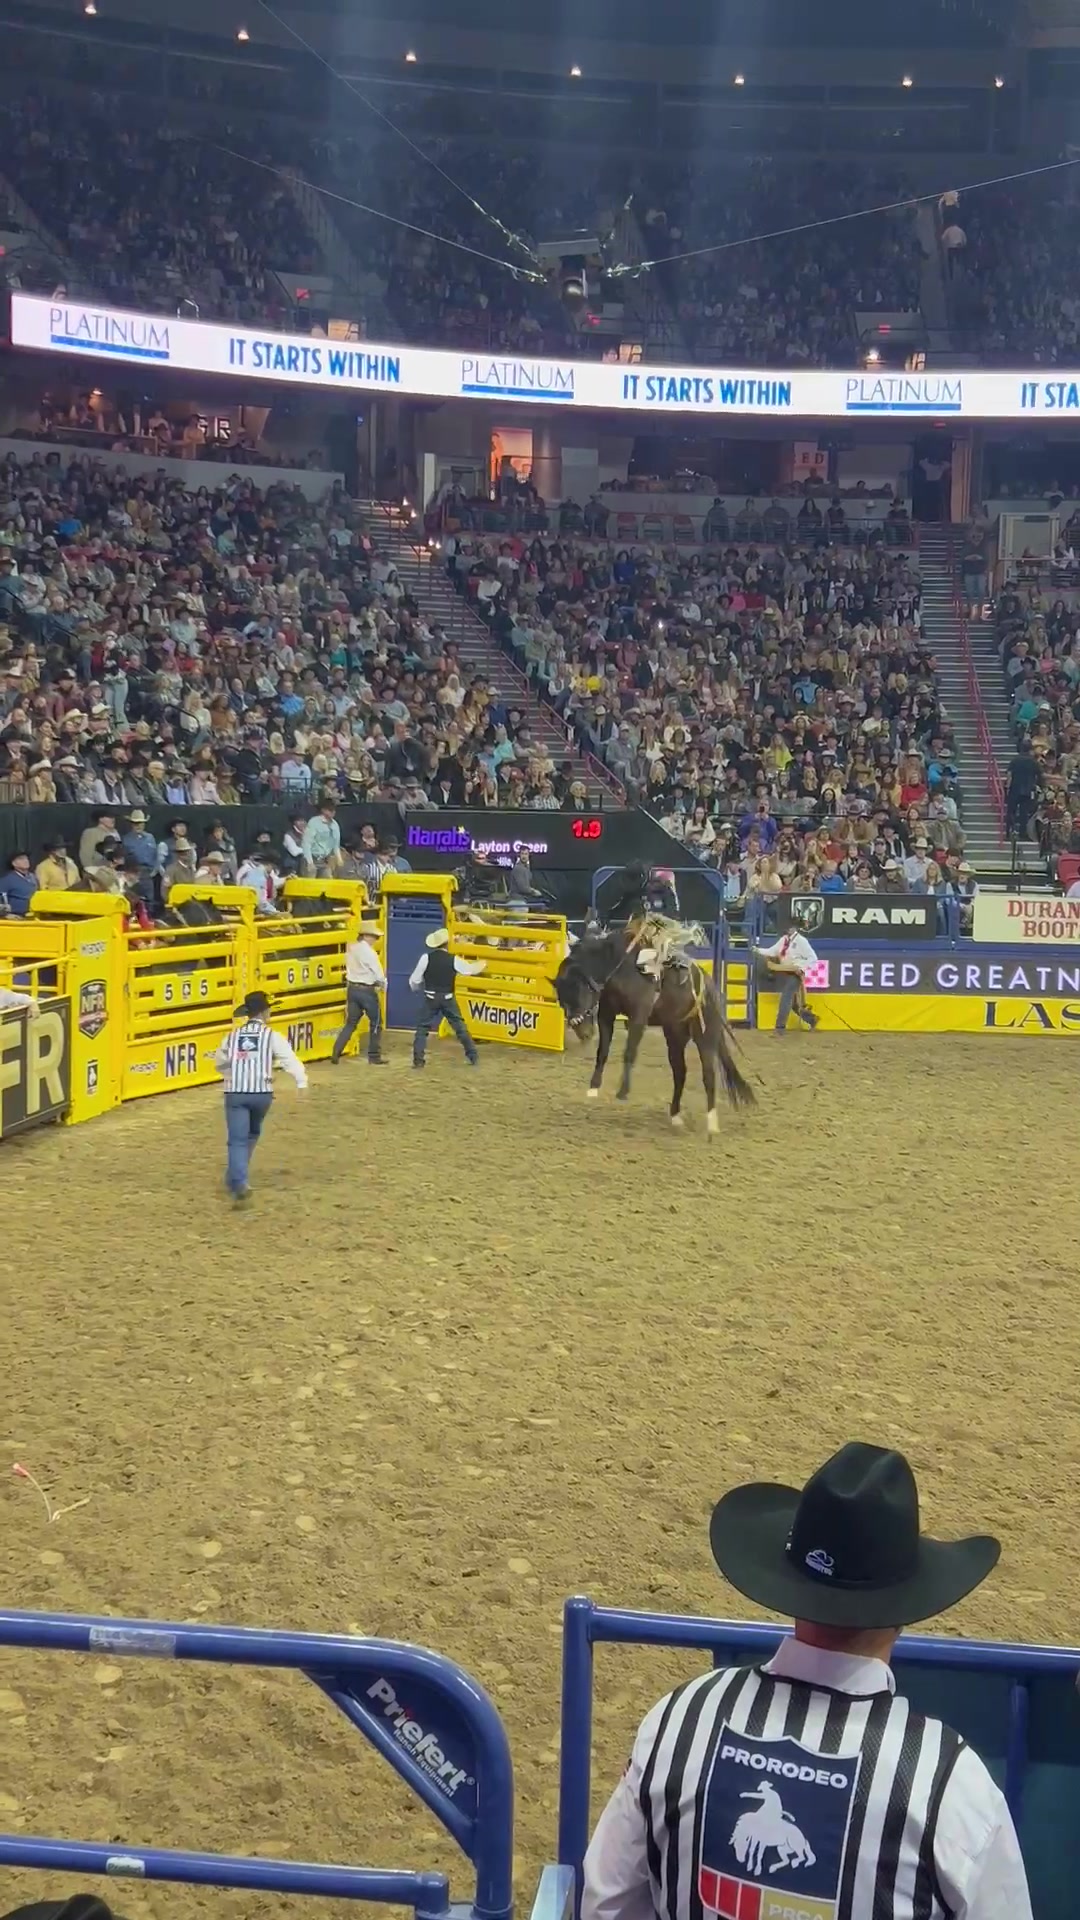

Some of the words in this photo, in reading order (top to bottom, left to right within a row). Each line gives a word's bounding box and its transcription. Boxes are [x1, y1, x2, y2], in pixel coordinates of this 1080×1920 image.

[50, 307, 170, 350] PLATINUM
[229, 338, 246, 365] IT
[252, 341, 322, 374] STARTS
[328, 349, 400, 383] WITHIN
[461, 359, 575, 390] PLATINUM
[623, 375, 640, 400] IT
[645, 376, 714, 403] STARTS
[719, 379, 792, 406] WITHIN
[846, 378, 963, 402] PLATINUM
[1021, 382, 1040, 408] IT
[1045, 382, 1079, 408] STA
[471, 839, 511, 855] Layton
[832, 907, 926, 925] RAM
[1007, 900, 1080, 919] DURAN
[1023, 920, 1080, 939] BOOT
[288, 968, 295, 984] 6
[317, 964, 324, 979] 6
[839, 962, 921, 988] FEED
[936, 963, 1080, 991] GREATN
[165, 983, 173, 1001] 5
[200, 979, 208, 996] 5
[468, 1000, 540, 1037] Wrangler
[287, 1022, 314, 1052] NFR
[165, 1042, 198, 1078] NFR
[393, 1728, 417, 1756] Ranch
[416, 1753, 455, 1798] Equipment
[720, 1745, 848, 1790] PRORODEO
